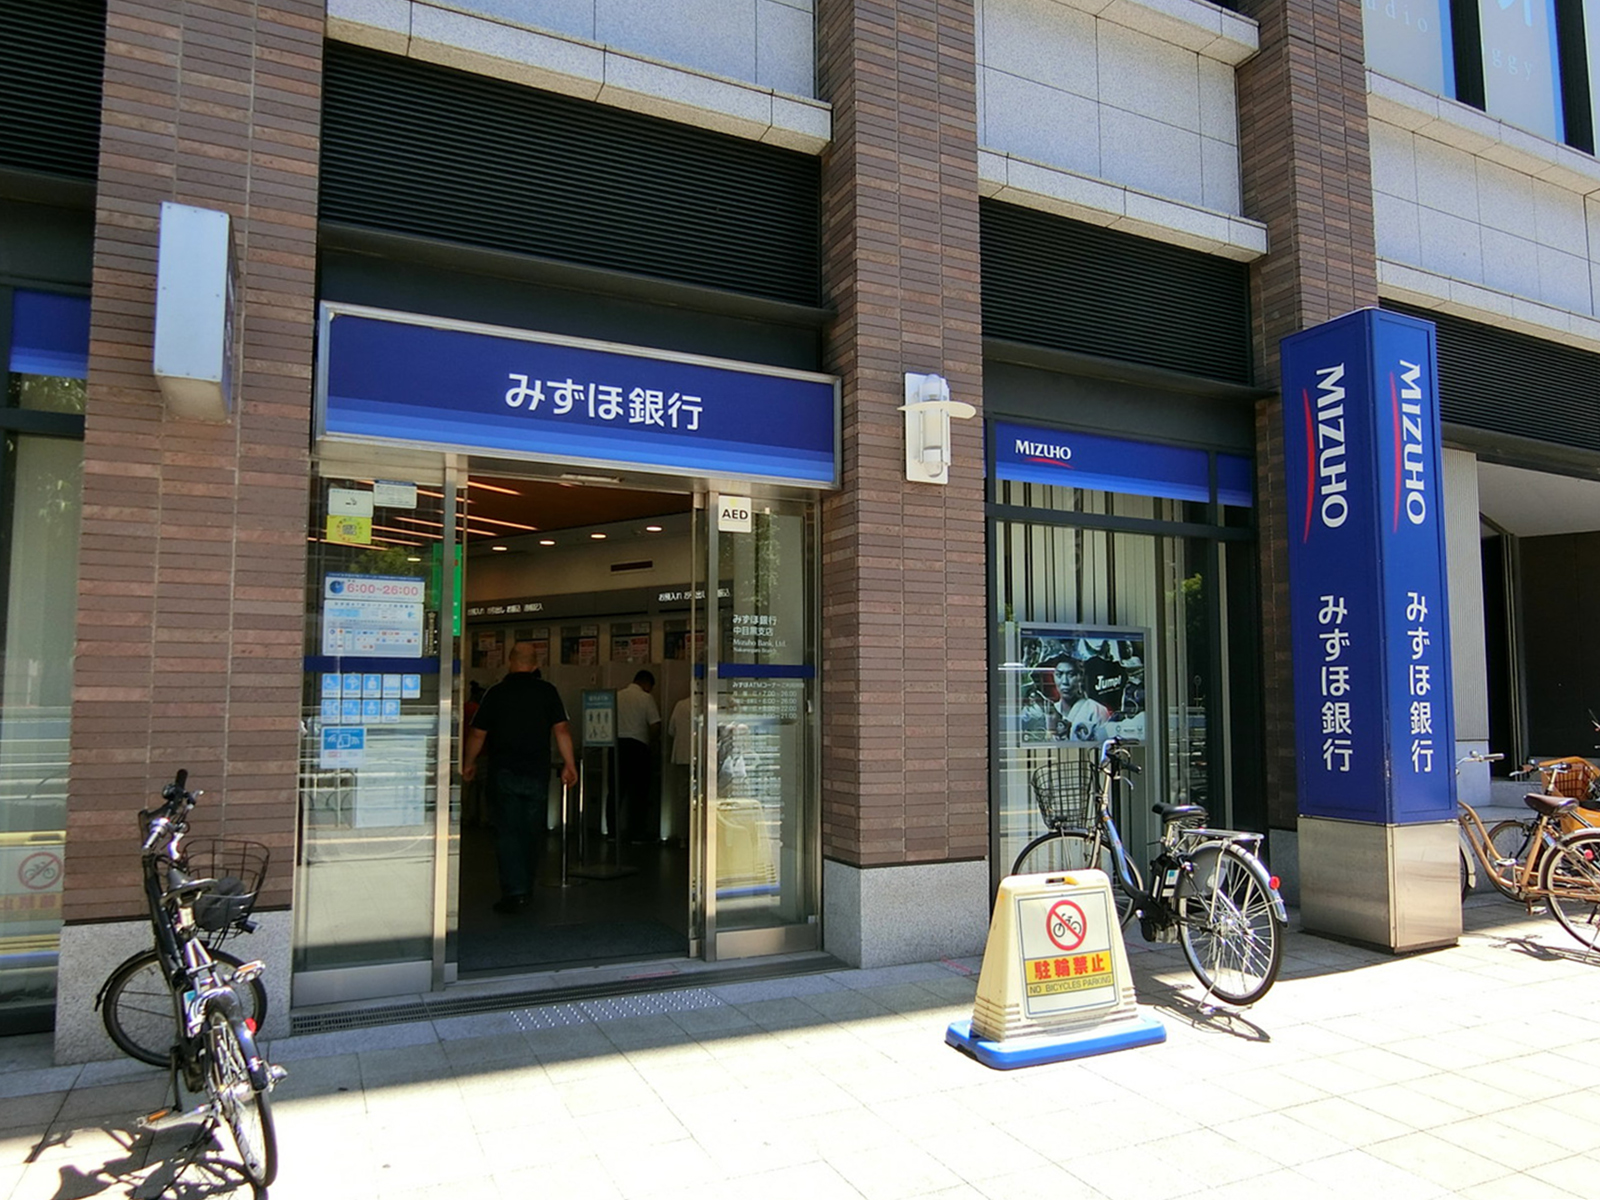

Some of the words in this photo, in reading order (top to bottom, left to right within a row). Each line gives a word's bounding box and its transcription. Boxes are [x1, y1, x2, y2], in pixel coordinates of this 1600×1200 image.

[505, 373, 703, 430] みずほ銀行
[1015, 439, 1071, 460] MIZUHO
[1316, 362, 1348, 528] MIZUHO
[1400, 359, 1426, 525] MIZUHO
[722, 508, 748, 520] AED
[733, 614, 777, 626] みずほ銀行
[1318, 595, 1353, 772] みずほ銀行
[1406, 592, 1433, 773] みずほ銀行
[1029, 985, 1041, 994] NO
[1045, 980, 1082, 992] BICYCLES
[1082, 975, 1112, 988] PARKING
[1034, 953, 1105, 980] 駐輪禁止
